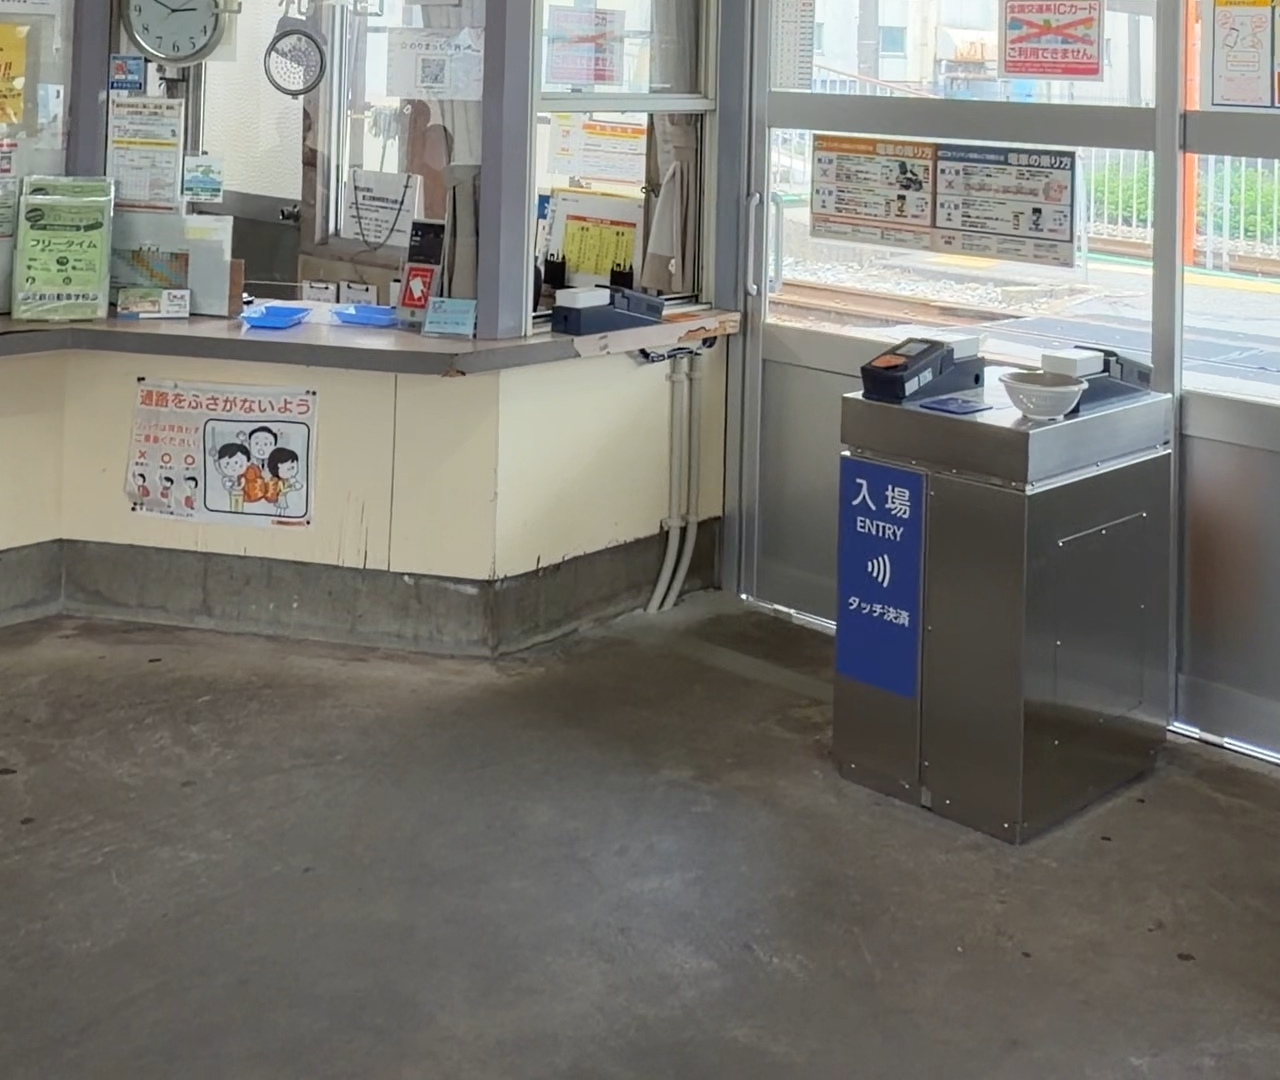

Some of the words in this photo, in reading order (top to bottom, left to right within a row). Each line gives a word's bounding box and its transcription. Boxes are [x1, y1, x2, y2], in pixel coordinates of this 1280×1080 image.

[134, 5, 142, 17] 9
[1009, 3, 1097, 15] 全国交通系ICカード
[142, 23, 150, 35] 8
[200, 25, 207, 36] 4
[155, 36, 163, 48] 7
[172, 41, 180, 53] 6
[189, 37, 196, 49] 5
[876, 143, 933, 159] 電車の乗り方
[1008, 152, 1072, 169] 電車の乗り方
[30, 239, 97, 249] フリータイム
[140, 388, 311, 415] 通路をふさがないよう
[851, 478, 912, 519] 入場
[856, 517, 904, 541] ENTRY
[847, 596, 910, 627] タッチ決済
